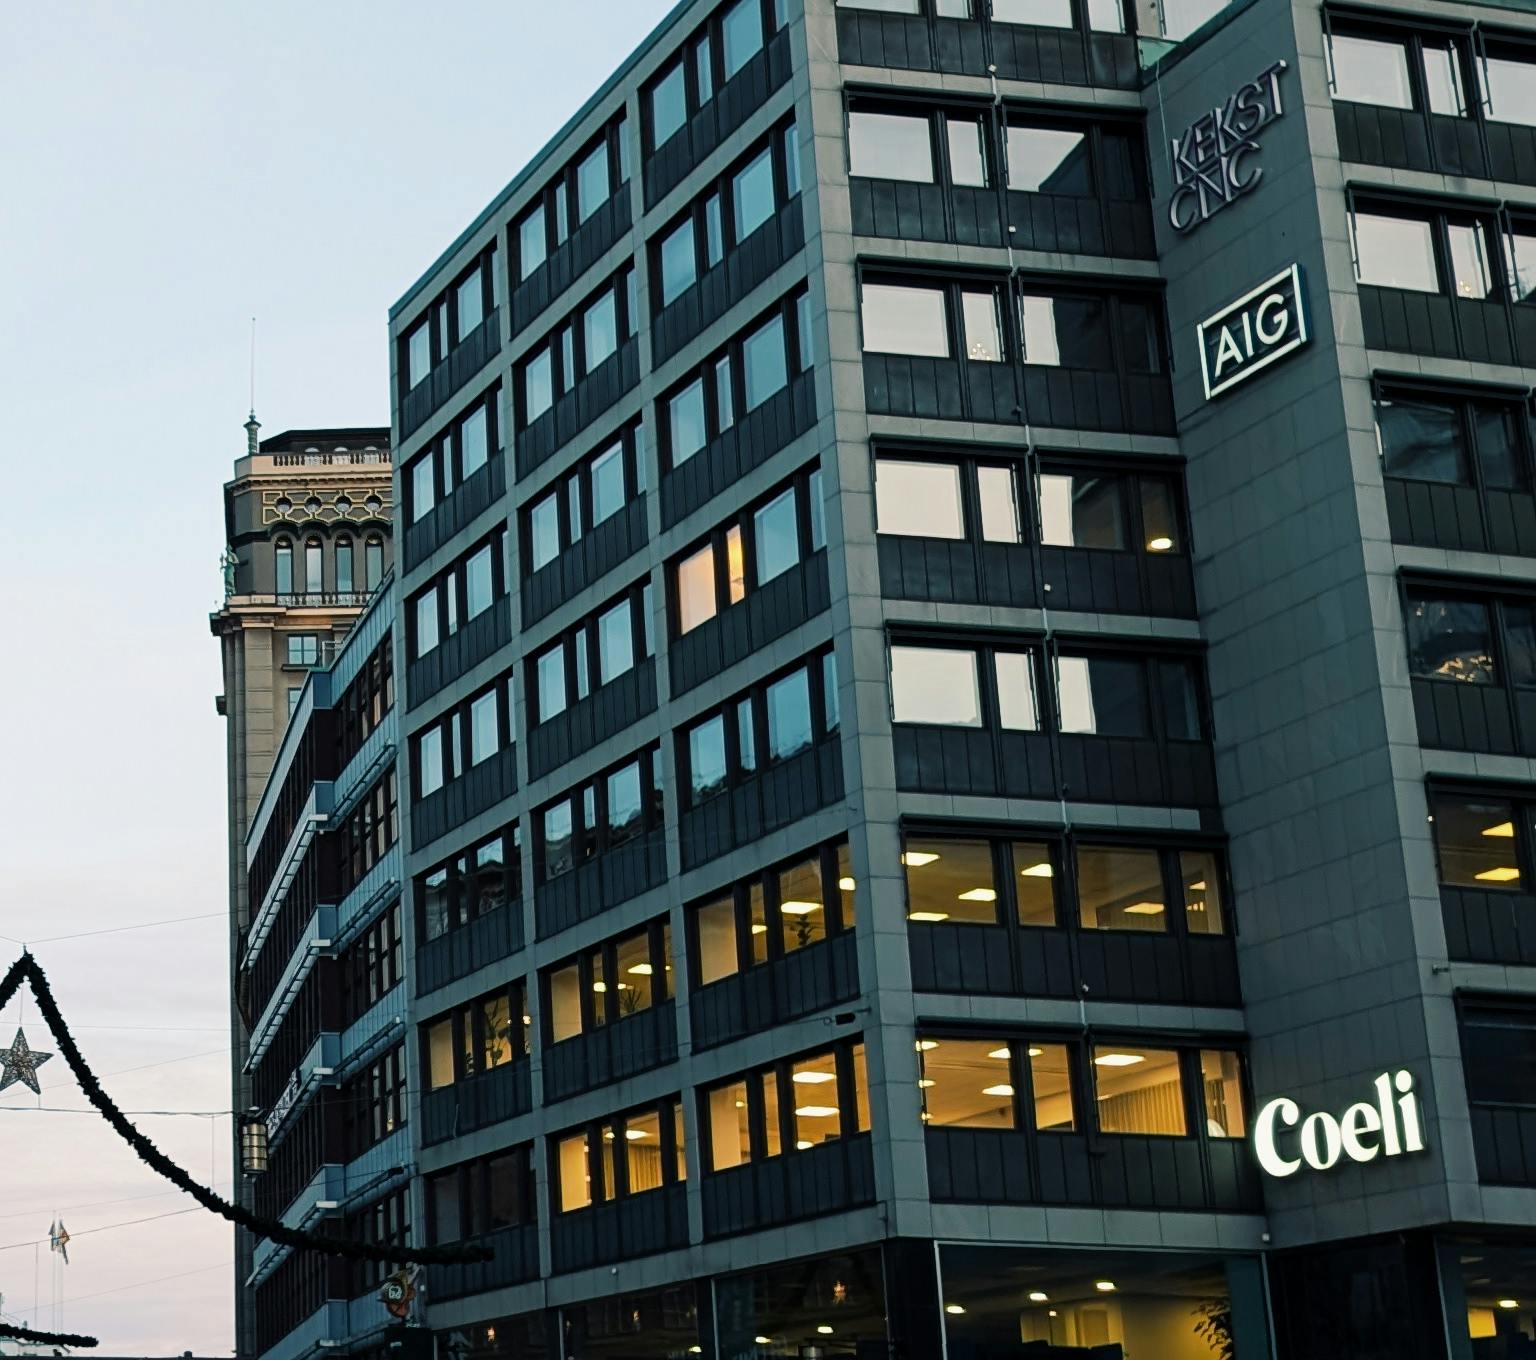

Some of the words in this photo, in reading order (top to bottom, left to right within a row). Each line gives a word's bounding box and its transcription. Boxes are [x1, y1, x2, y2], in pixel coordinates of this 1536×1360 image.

[1171, 59, 1288, 185] KEKST
[1168, 140, 1263, 233] CNC
[1214, 292, 1289, 378] AIG
[1254, 1069, 1425, 1178] Coeli
